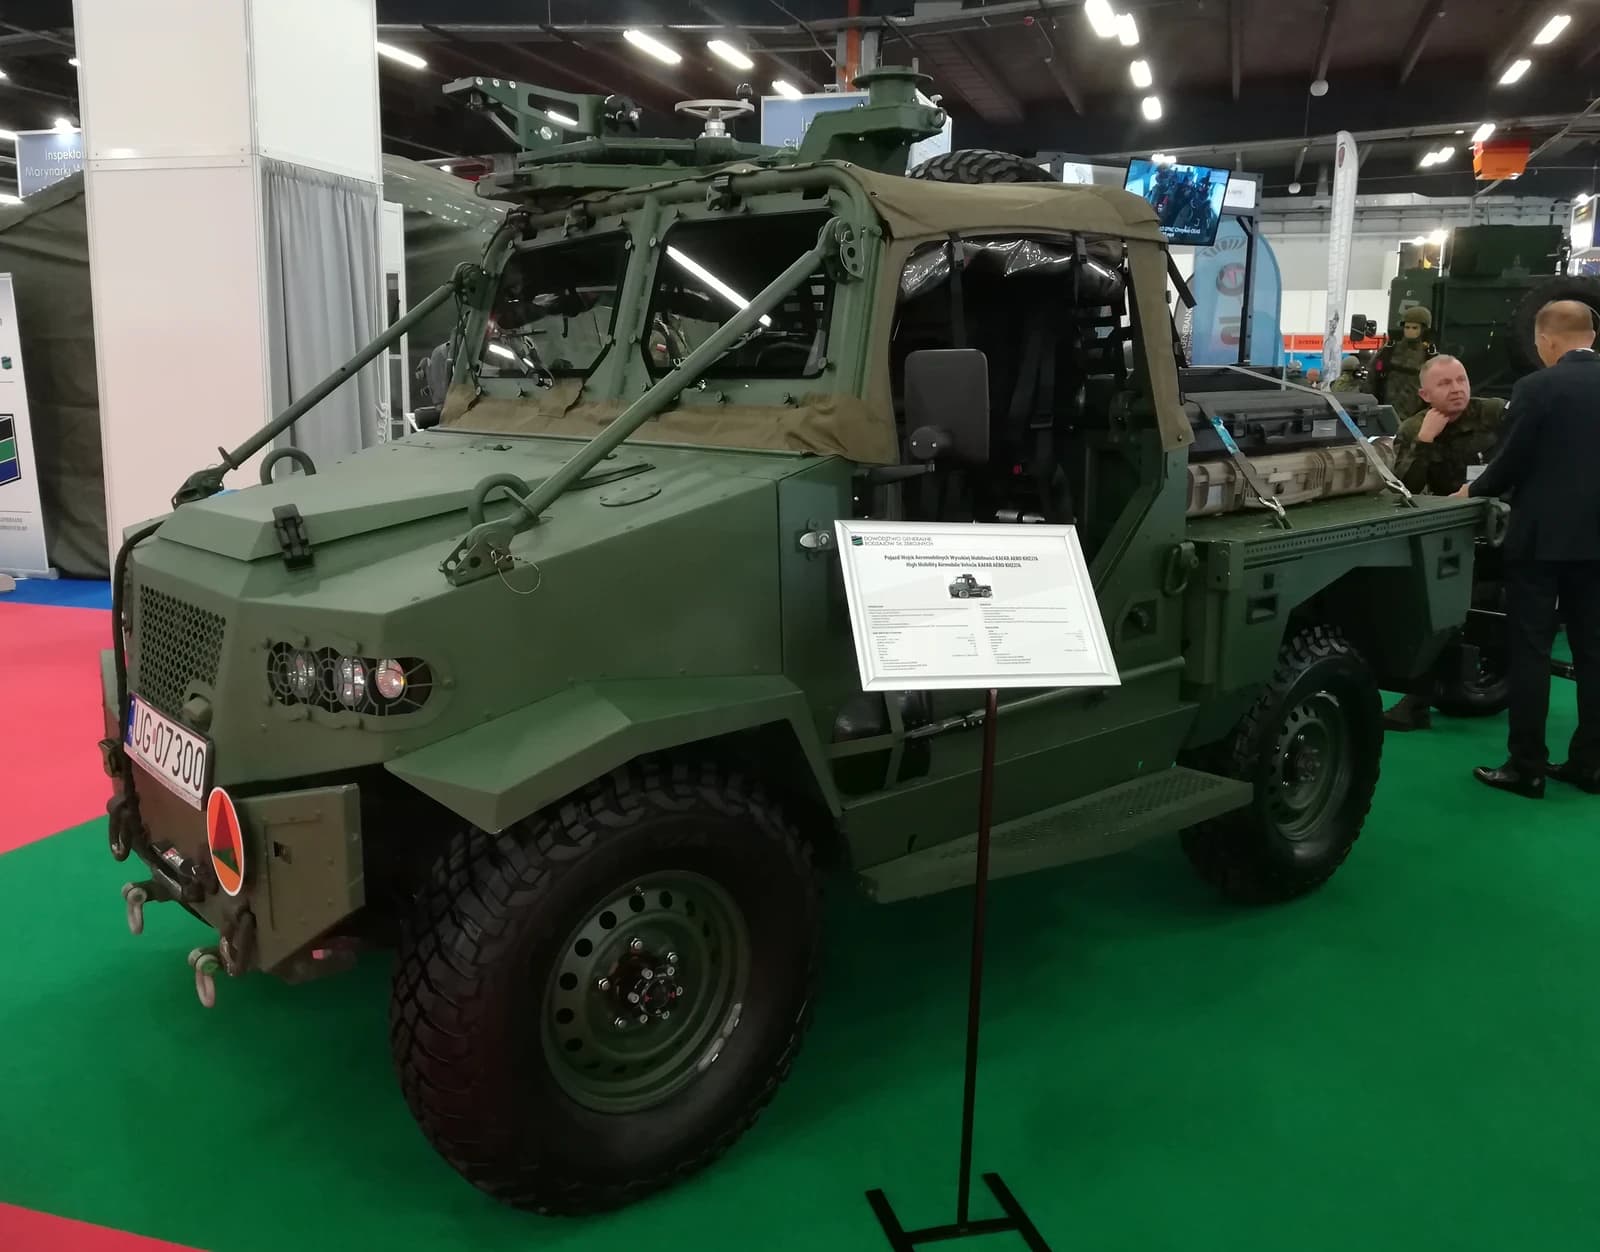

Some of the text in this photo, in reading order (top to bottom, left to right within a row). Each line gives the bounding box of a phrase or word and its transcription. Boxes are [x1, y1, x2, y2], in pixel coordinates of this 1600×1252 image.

[45, 147, 84, 163] Inspekto
[25, 163, 71, 179] Marynarki
[134, 704, 205, 791] UG 07300
